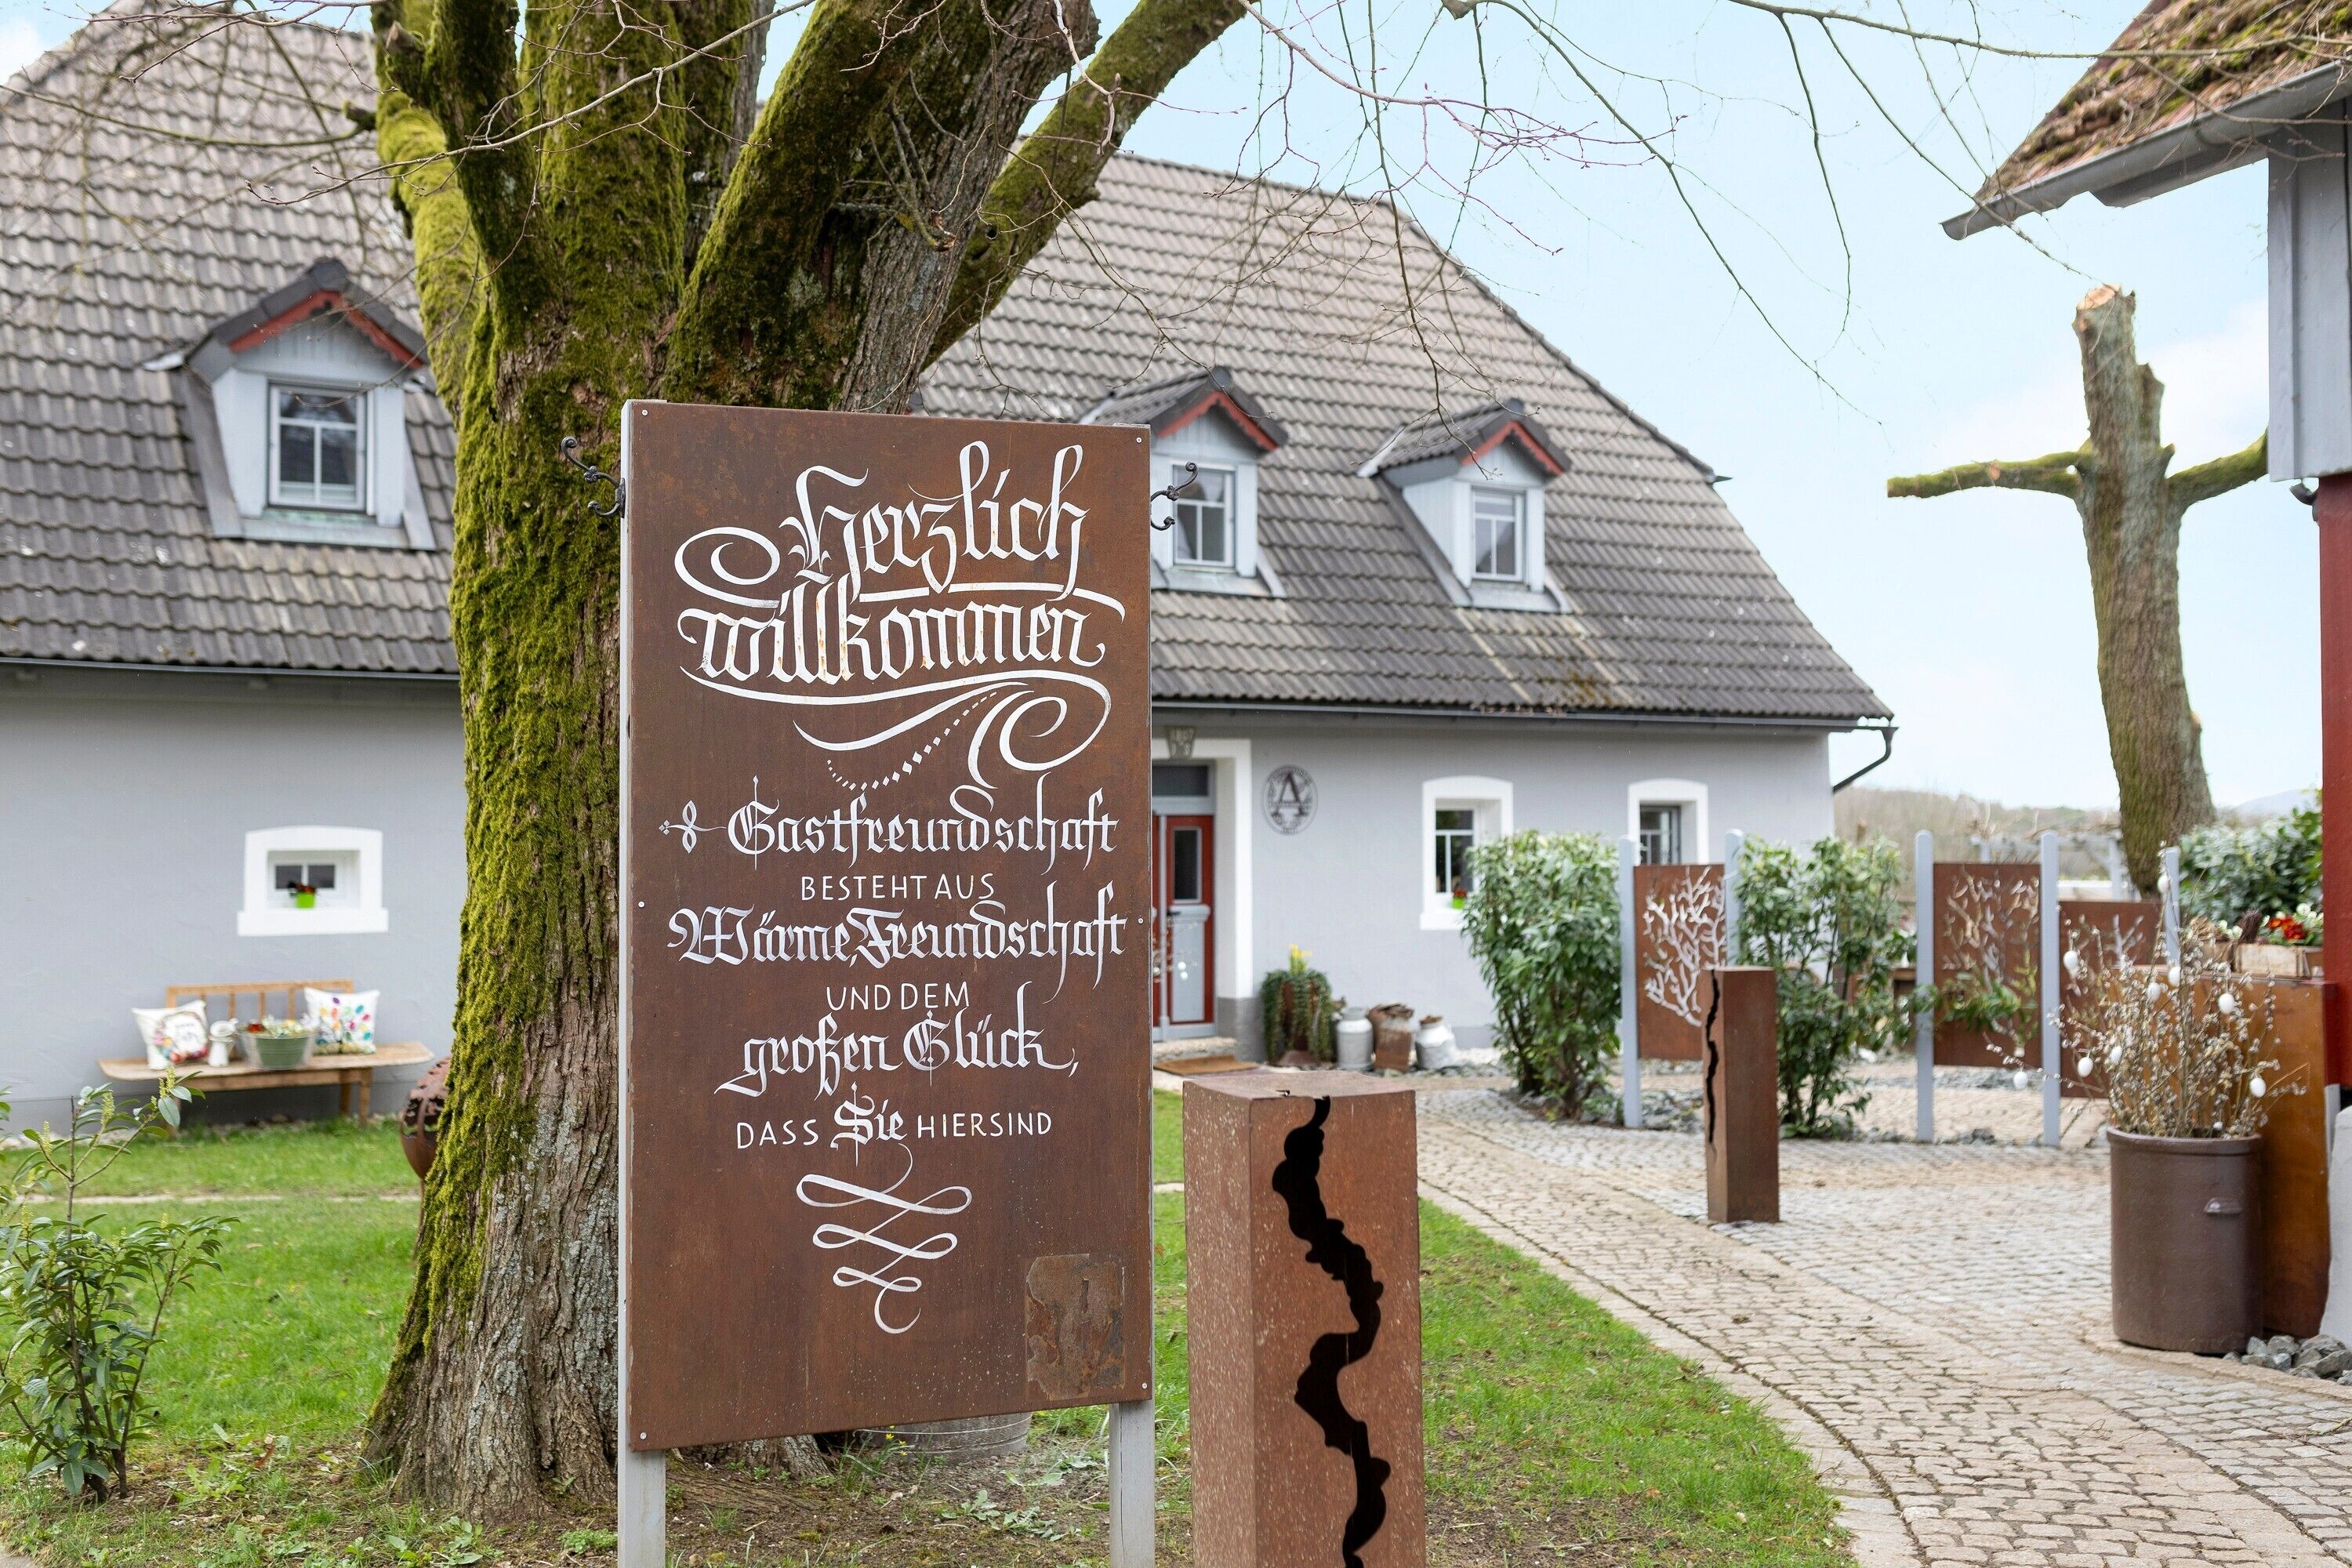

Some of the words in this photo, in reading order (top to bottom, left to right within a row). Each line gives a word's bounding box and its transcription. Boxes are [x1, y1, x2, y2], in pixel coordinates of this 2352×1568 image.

[779, 441, 1091, 601] Herzlich
[677, 573, 1106, 685] willkommen
[728, 773, 1120, 875] Gastfreundschaft
[801, 876, 927, 901] BESTEHT
[935, 873, 994, 899] AUS
[667, 904, 857, 967] Wärme,
[846, 881, 1127, 1004] Freundschaft
[715, 1013, 902, 1101] großen
[903, 982, 1078, 1087] Glück,
[826, 985, 891, 1011] UND
[901, 982, 969, 1010] DEM
[737, 1119, 818, 1149] DASS
[830, 1082, 908, 1167] Sie
